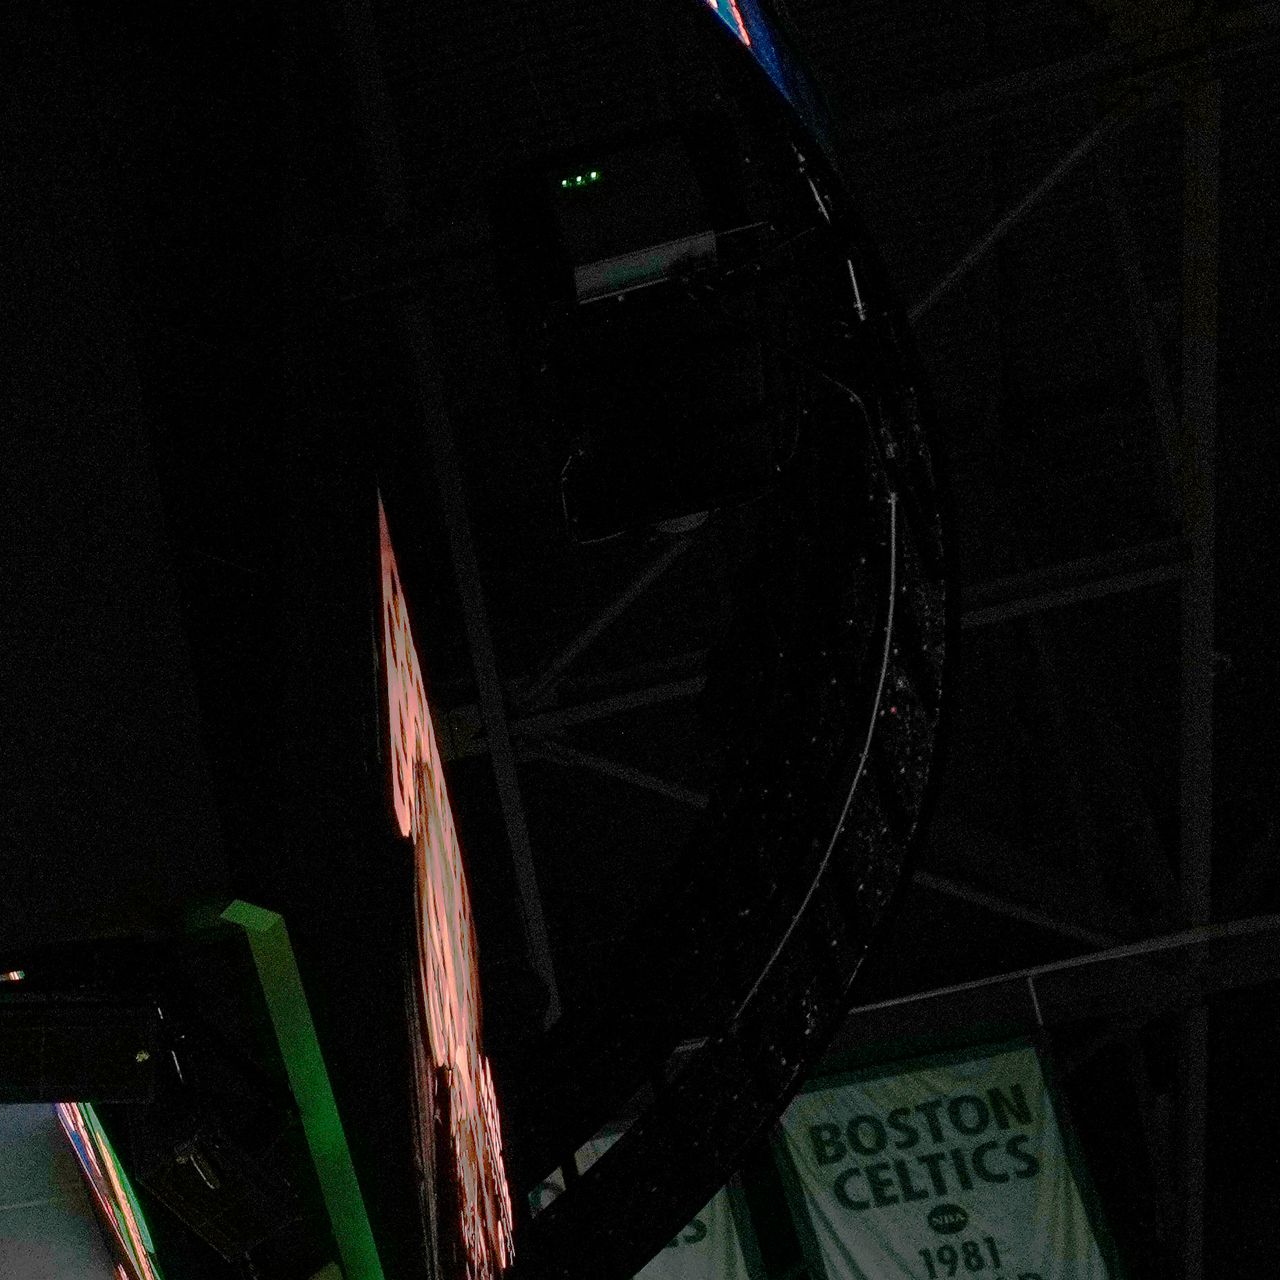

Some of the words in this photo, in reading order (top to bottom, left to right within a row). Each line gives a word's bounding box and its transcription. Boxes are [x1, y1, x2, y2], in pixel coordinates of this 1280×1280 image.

[808, 1082, 1034, 1166] BOSTON
[833, 1133, 1042, 1211] CELTICS
[918, 1236, 1002, 1280] 1981
